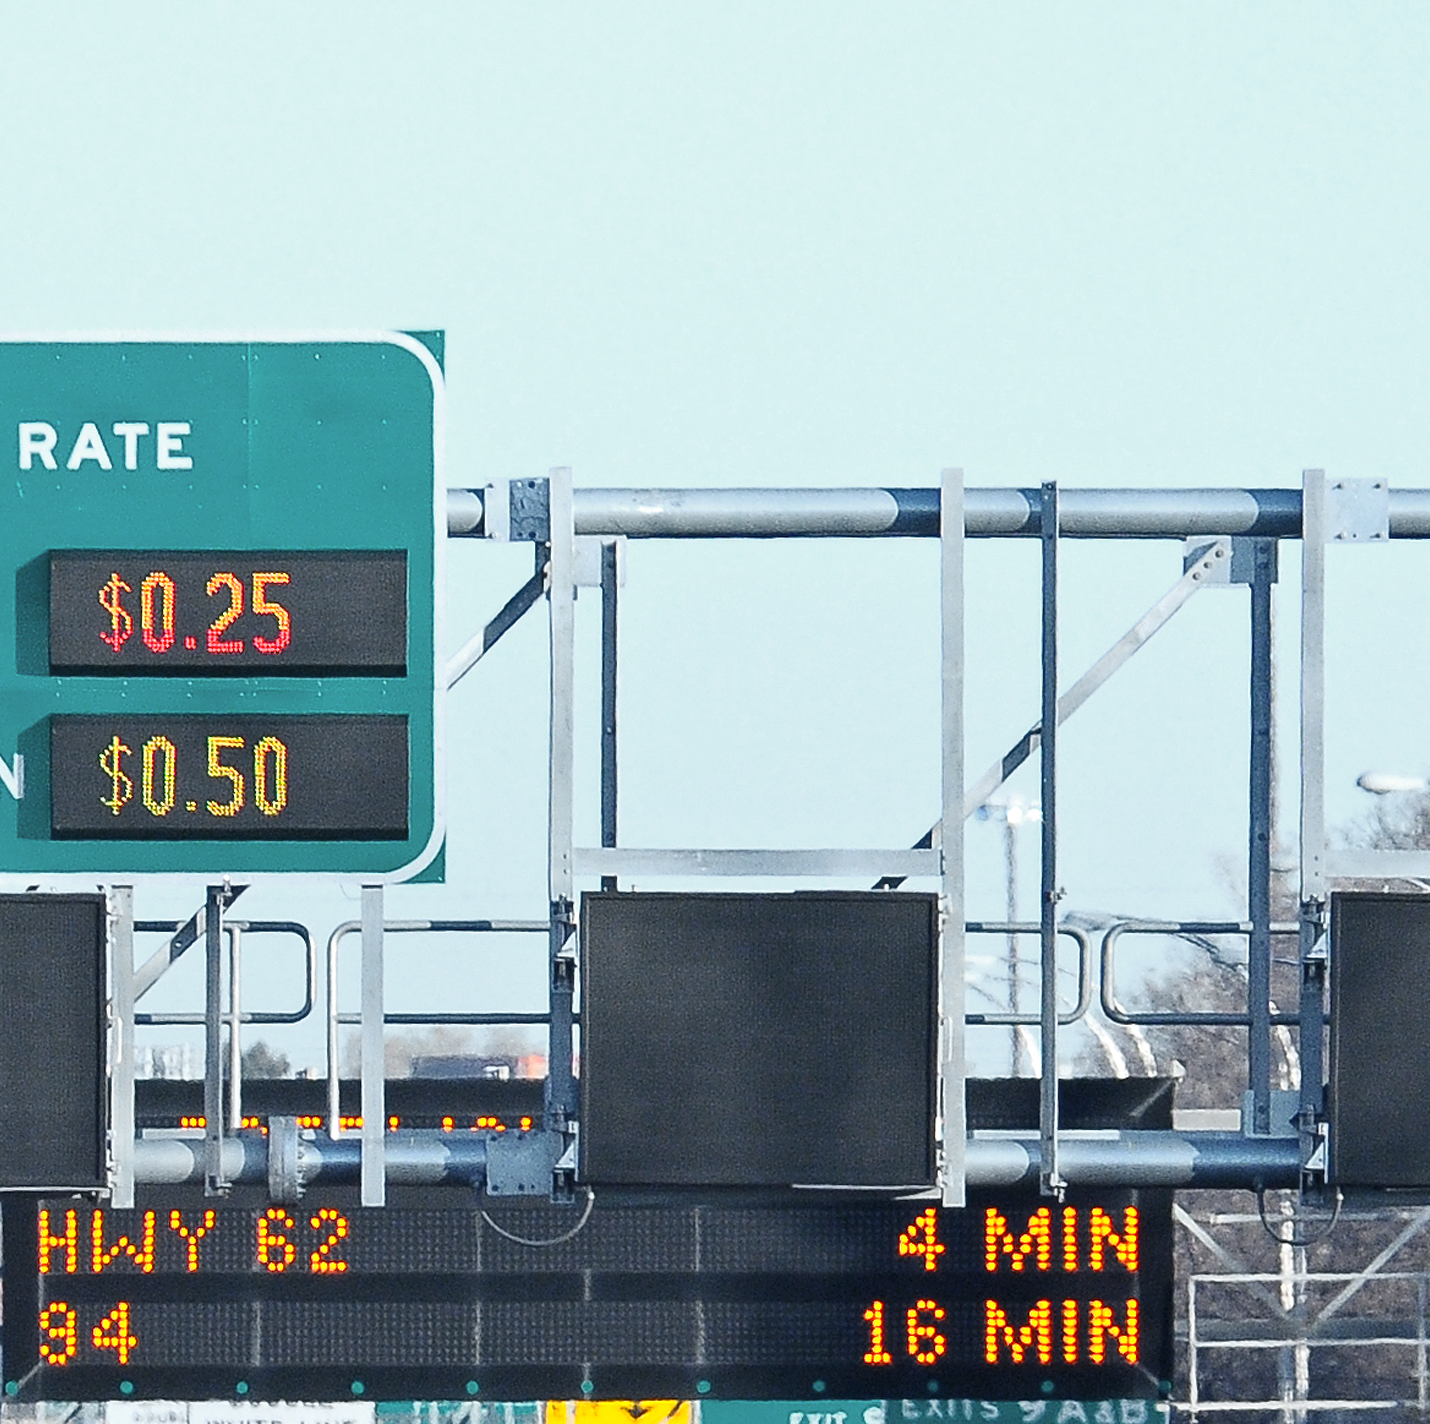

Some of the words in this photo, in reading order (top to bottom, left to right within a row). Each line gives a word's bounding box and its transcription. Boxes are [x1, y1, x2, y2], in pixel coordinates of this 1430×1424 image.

[19, 422, 193, 470] RATE
[99, 572, 293, 654] $0.25
[99, 736, 288, 817] $0.50
[37, 1208, 216, 1274] HWY
[256, 1207, 347, 1273] 62
[898, 1206, 945, 1271] 4
[985, 1206, 1138, 1272] MIN
[38, 1301, 138, 1365] 94
[864, 1300, 946, 1365] 16
[985, 1299, 1138, 1365] MIN
[901, 1399, 1000, 1421] EXITS
